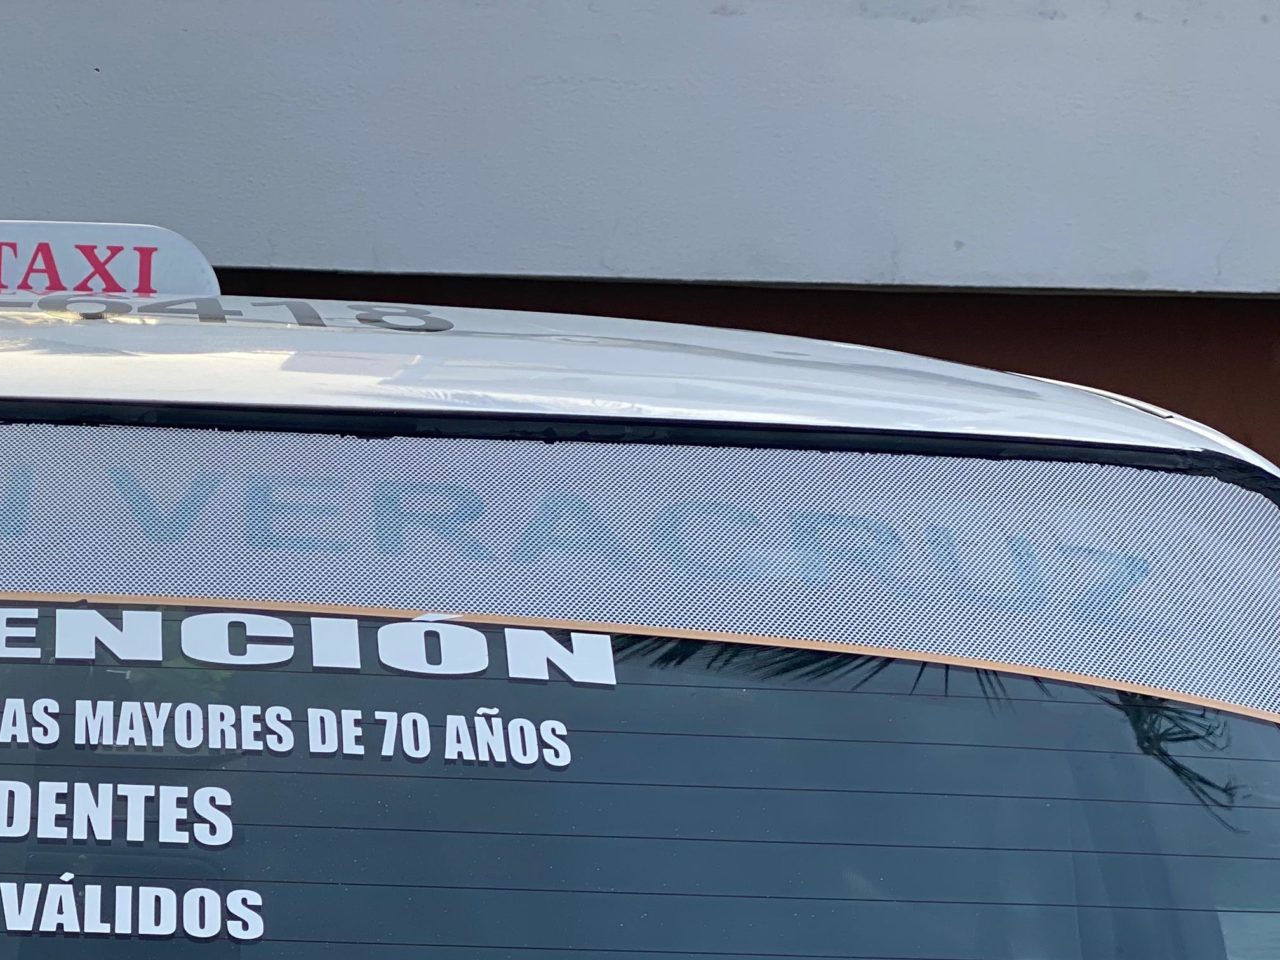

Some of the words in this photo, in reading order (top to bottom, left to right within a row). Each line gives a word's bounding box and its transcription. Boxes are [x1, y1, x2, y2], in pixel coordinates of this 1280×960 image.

[74, 700, 294, 752] MAYORES
[307, 707, 365, 755] DE
[374, 710, 431, 759] 70
[444, 707, 572, 767] AÑOS
